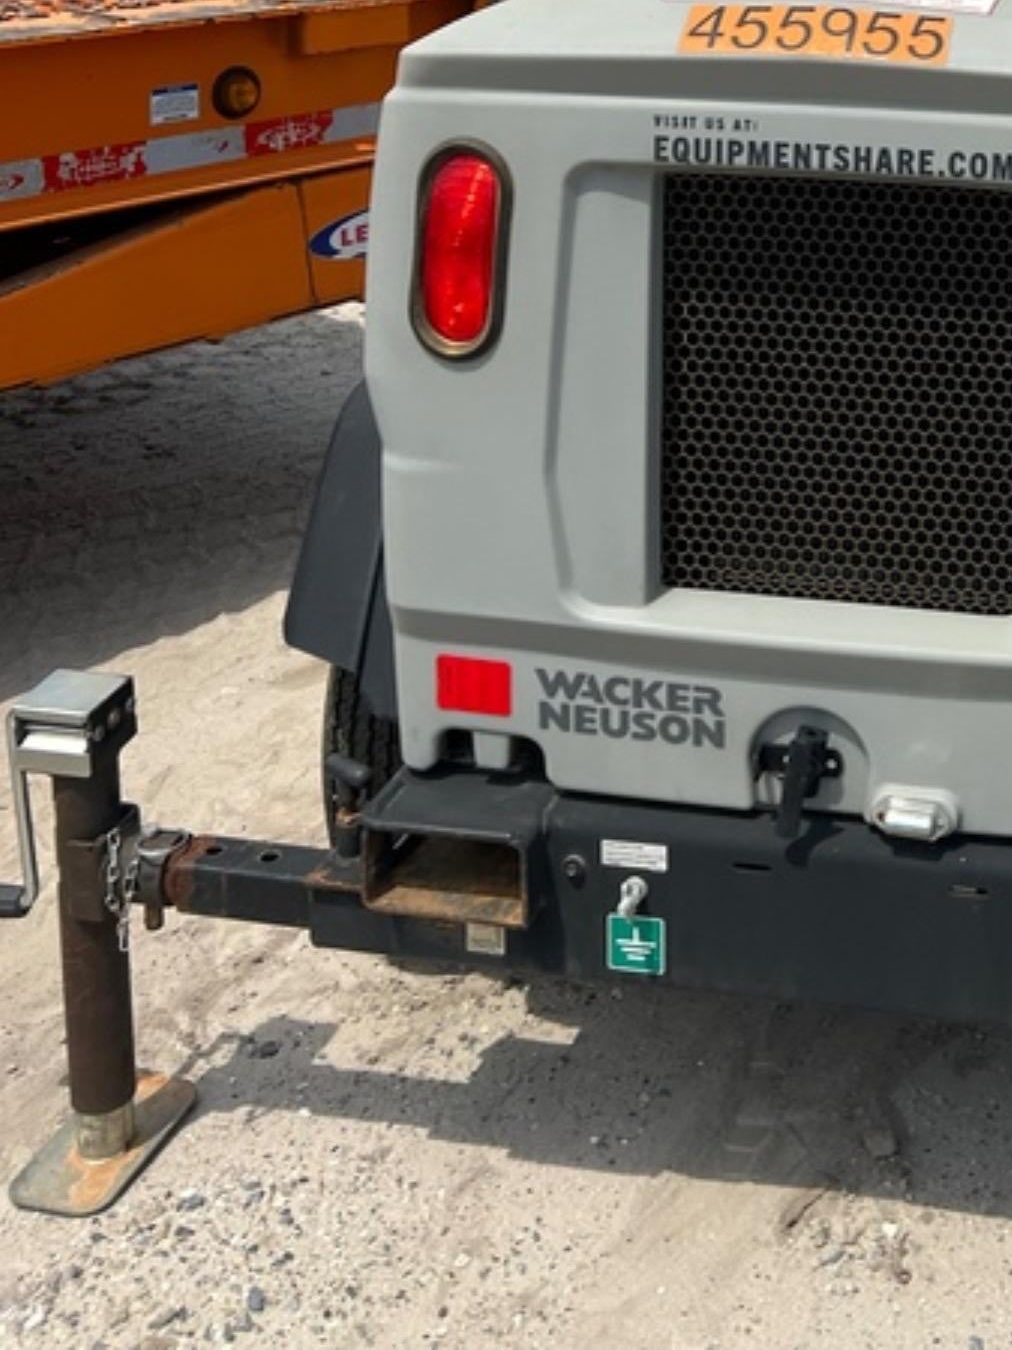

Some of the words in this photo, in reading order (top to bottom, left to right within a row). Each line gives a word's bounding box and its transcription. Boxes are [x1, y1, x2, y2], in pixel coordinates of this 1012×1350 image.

[688, 4, 946, 60] 455955
[653, 115, 697, 130] VISIT
[704, 117, 724, 131] US
[534, 667, 725, 717] WACKER
[538, 701, 726, 750] NEUSON
